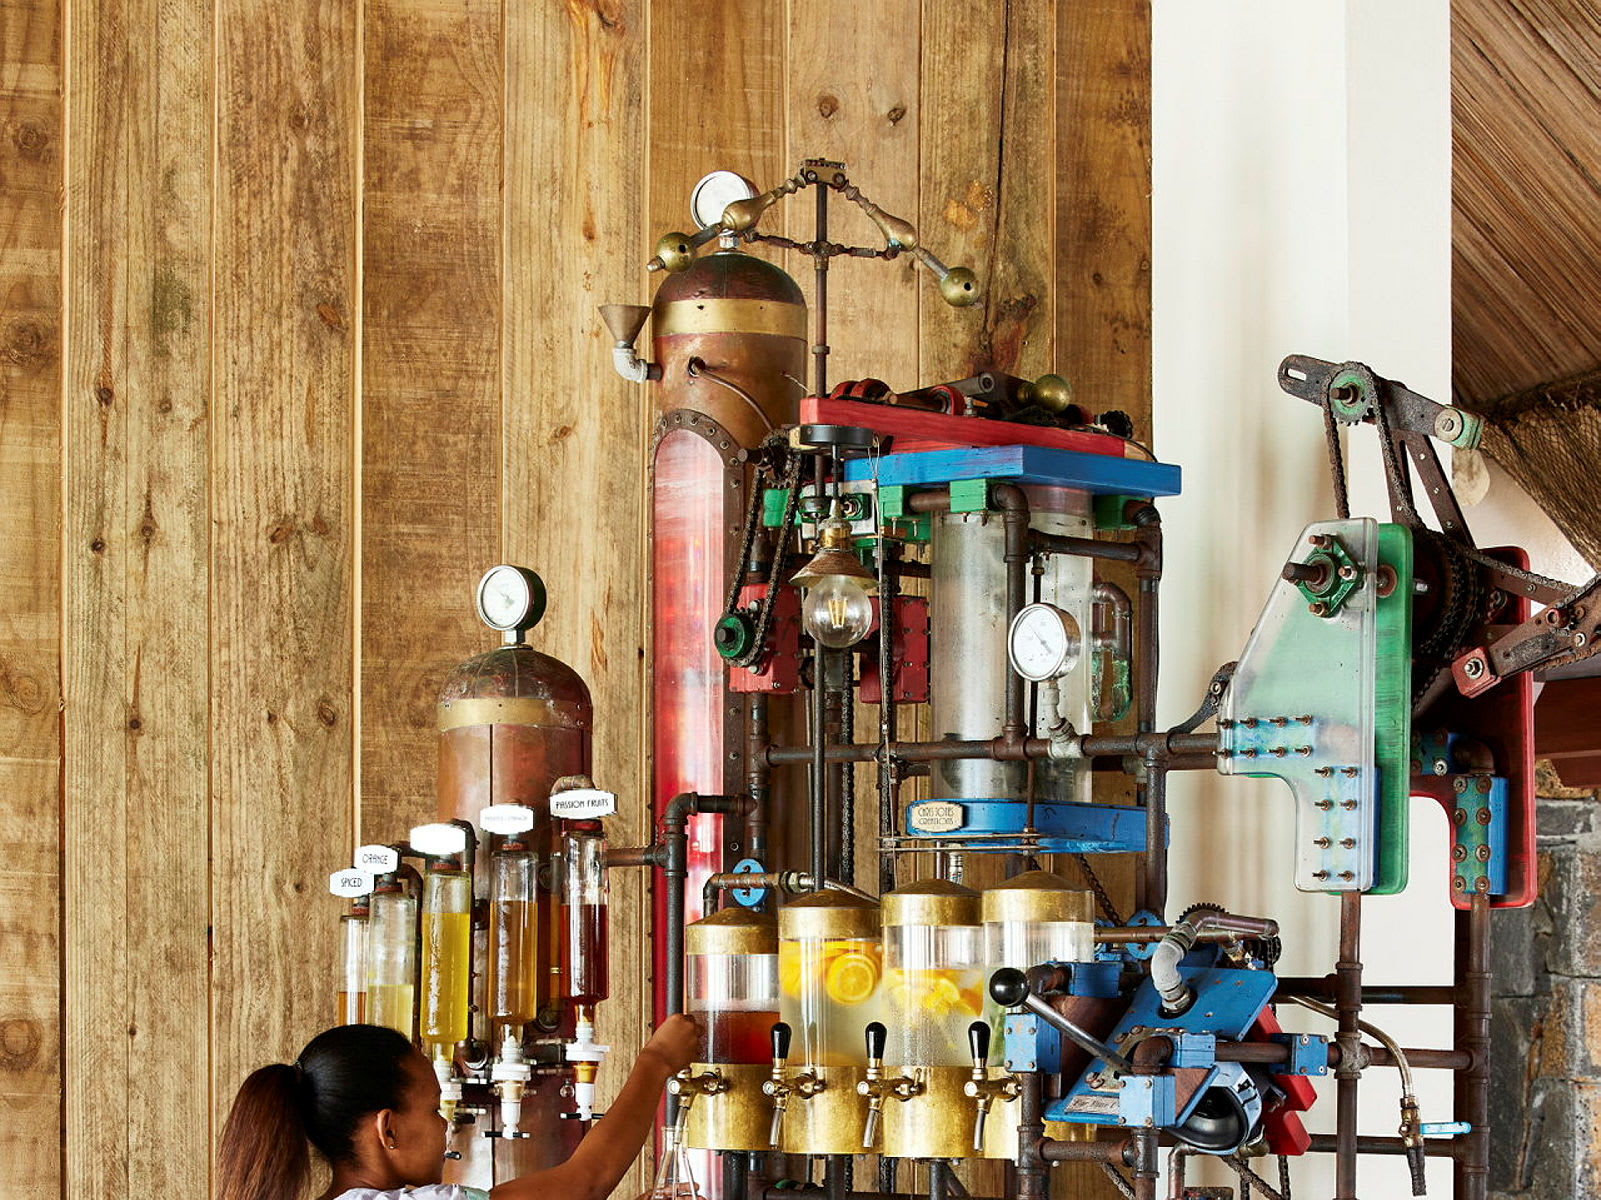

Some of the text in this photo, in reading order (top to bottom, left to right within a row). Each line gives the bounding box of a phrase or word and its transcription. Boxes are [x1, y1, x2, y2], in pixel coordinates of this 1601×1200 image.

[556, 801, 585, 809] PASSION
[362, 853, 388, 865] ORANGE
[340, 877, 363, 888] SPICED
